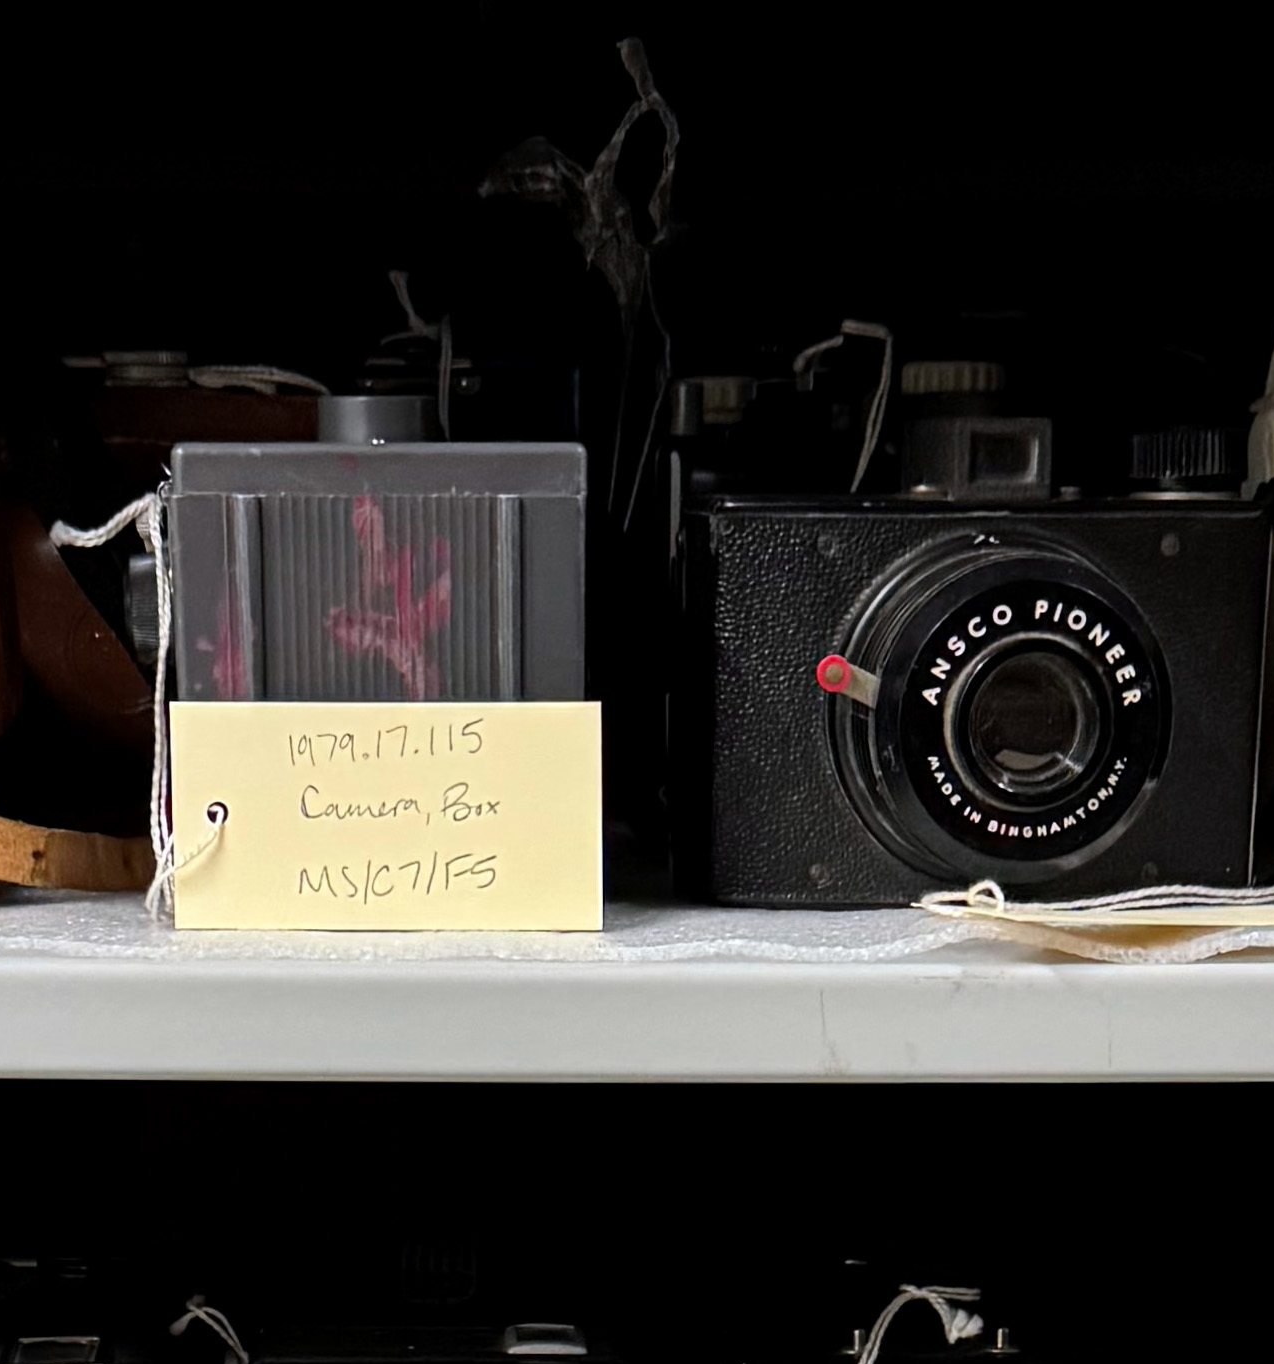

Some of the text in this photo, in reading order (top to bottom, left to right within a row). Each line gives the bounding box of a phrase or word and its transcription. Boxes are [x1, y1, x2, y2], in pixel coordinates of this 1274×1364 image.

[921, 600, 1142, 706] ANSCO PIONEER
[289, 718, 484, 766] 1979.17.115
[441, 782, 501, 822] Box
[927, 755, 960, 806] MADE
[963, 805, 981, 824] IN
[299, 852, 497, 905] MS/C7/F5
